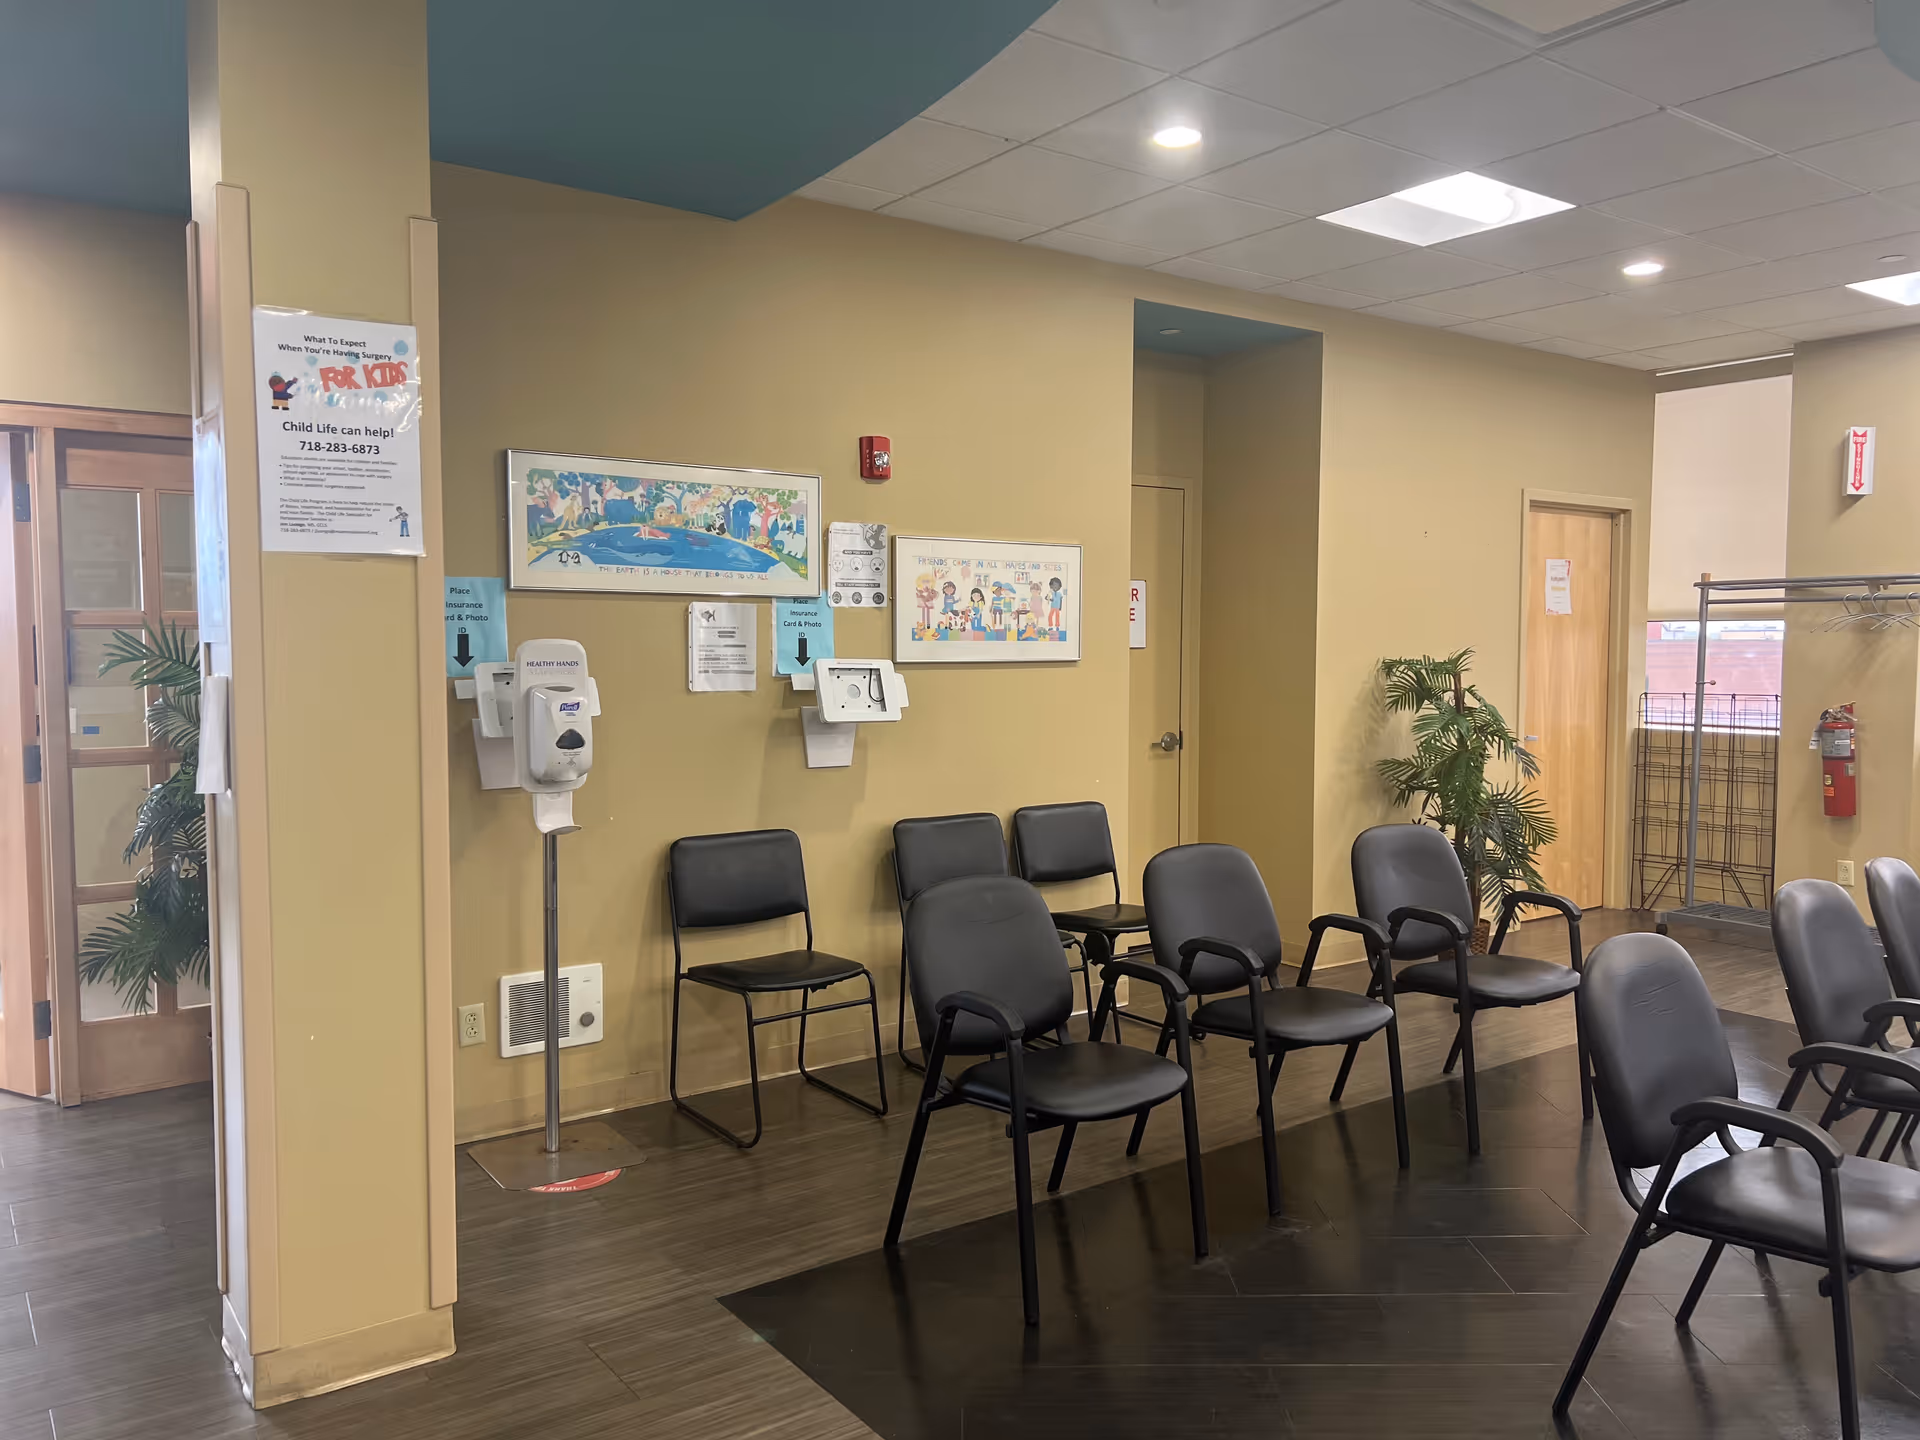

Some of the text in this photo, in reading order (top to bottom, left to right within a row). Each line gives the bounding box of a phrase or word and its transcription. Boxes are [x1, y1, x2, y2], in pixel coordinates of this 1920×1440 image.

[304, 335, 326, 343] What
[340, 339, 366, 347] Expect
[278, 343, 391, 361] When You're Having Surgery
[320, 361, 408, 392] FOR KIDS
[282, 421, 394, 439] Child Life can help!
[300, 440, 380, 454] 718-283-6873
[457, 613, 464, 621] &
